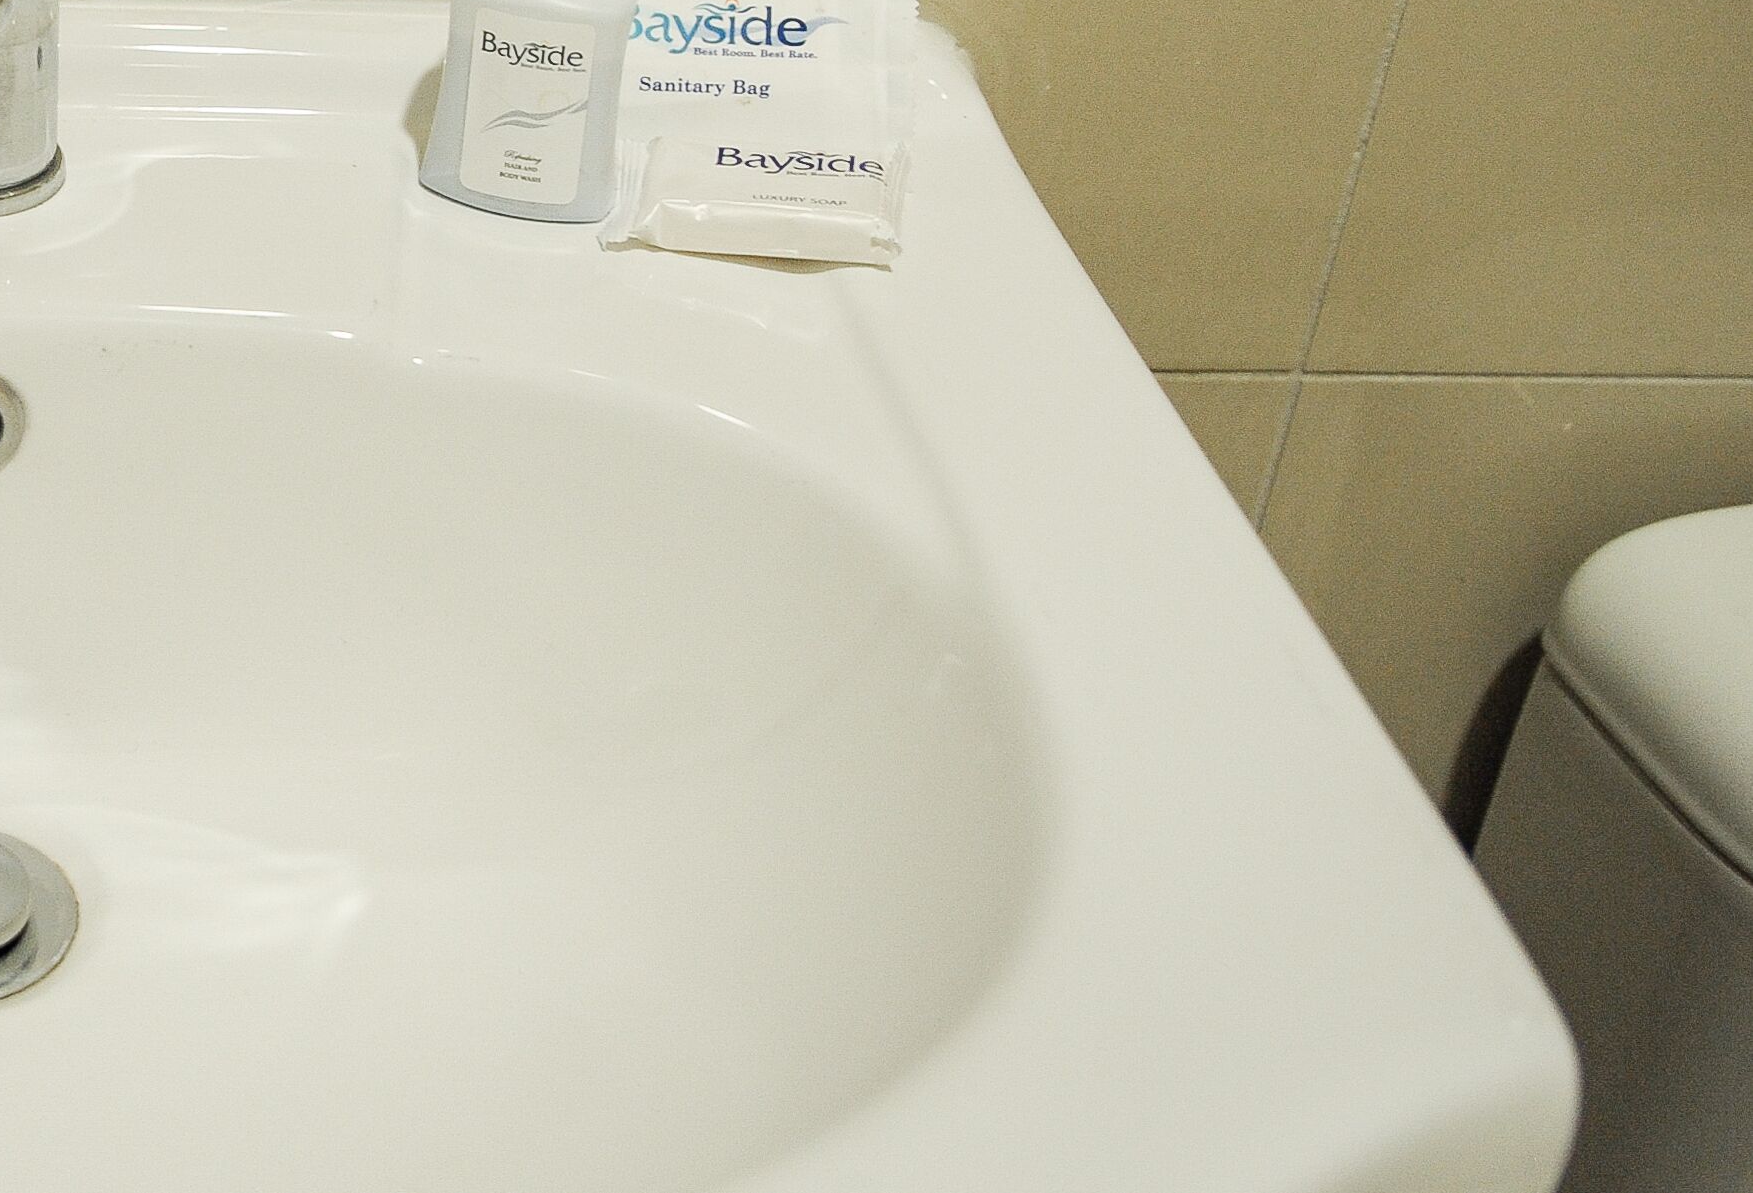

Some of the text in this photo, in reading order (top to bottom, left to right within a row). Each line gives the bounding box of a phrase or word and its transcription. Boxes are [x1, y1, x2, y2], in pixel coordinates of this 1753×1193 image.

[482, 30, 584, 67] Bayside
[638, 76, 771, 99] Sanitary Bag
[716, 146, 885, 175] Bayside
